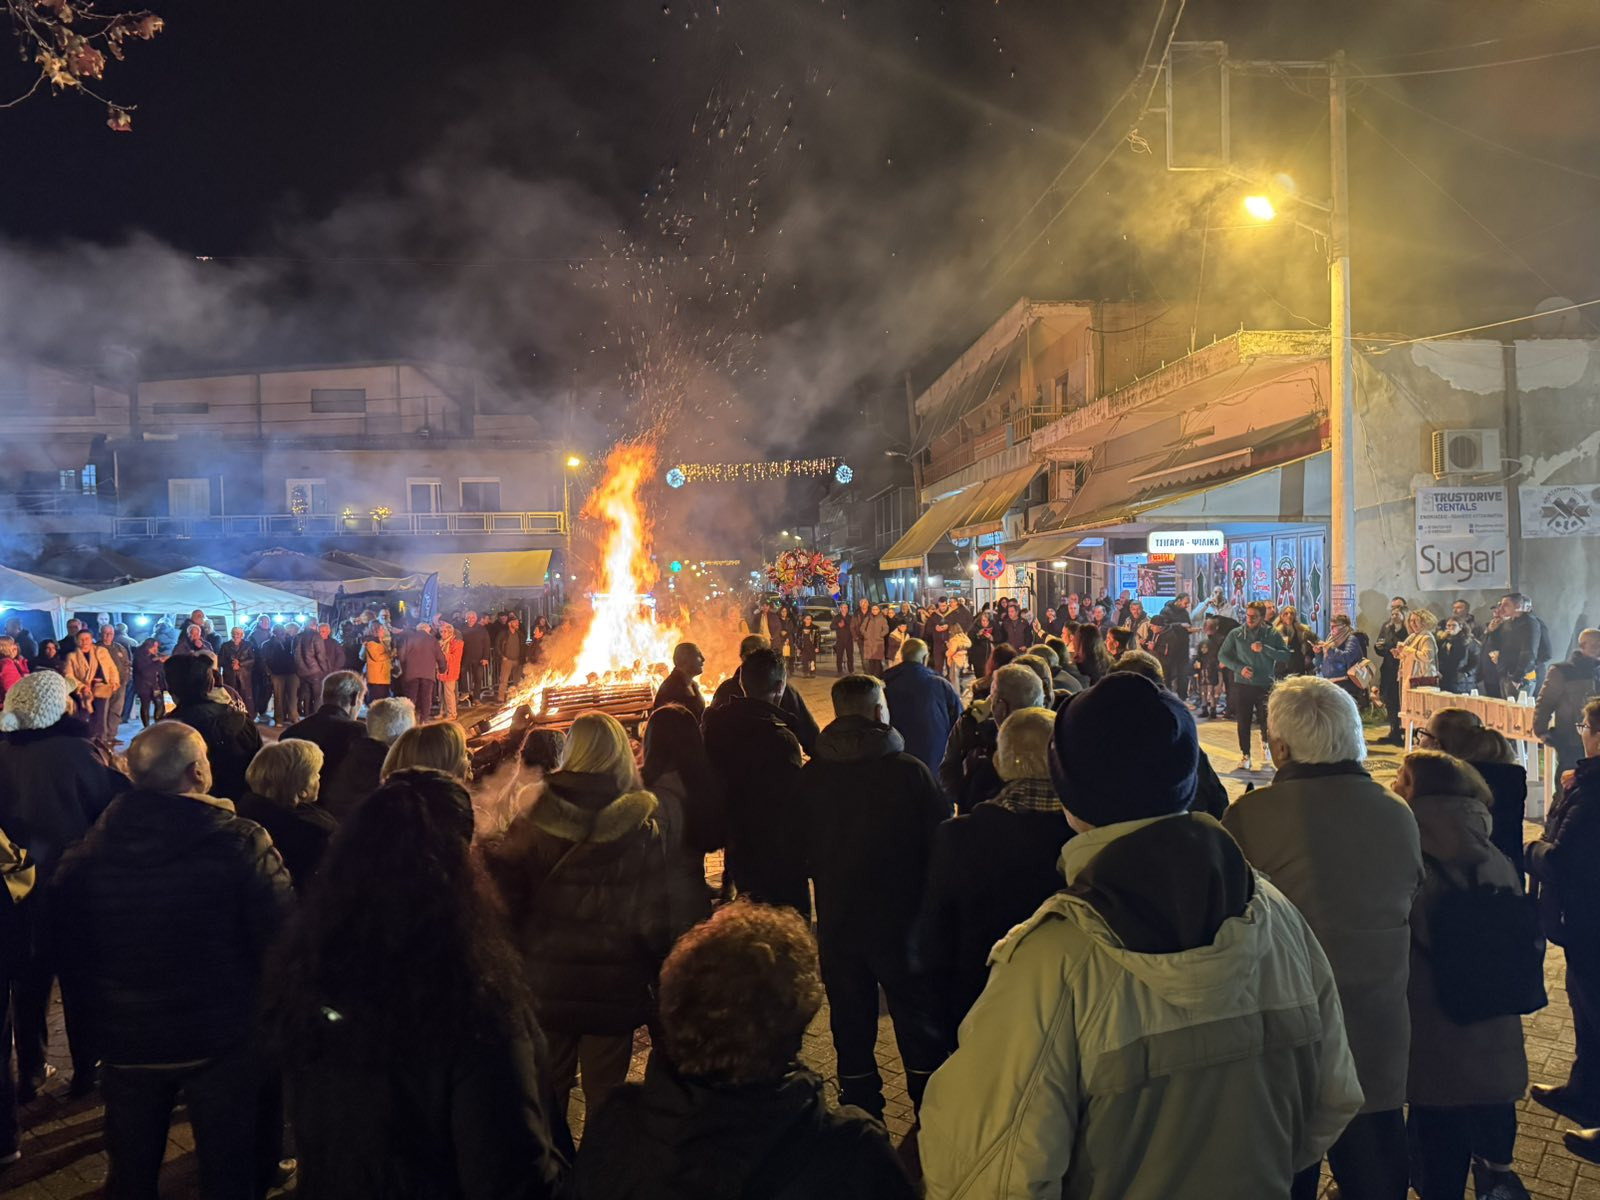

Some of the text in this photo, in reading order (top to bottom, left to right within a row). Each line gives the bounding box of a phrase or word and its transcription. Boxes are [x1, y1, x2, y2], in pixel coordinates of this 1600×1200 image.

[1434, 492, 1502, 502] TRUSTDRIVE
[1436, 503, 1477, 512] RENTALS
[1156, 538, 1185, 547] ΤΣΙΓΑΡΑ
[1192, 538, 1219, 546] ΨΙΛΙΚΑ
[1420, 545, 1505, 583] Sugar
